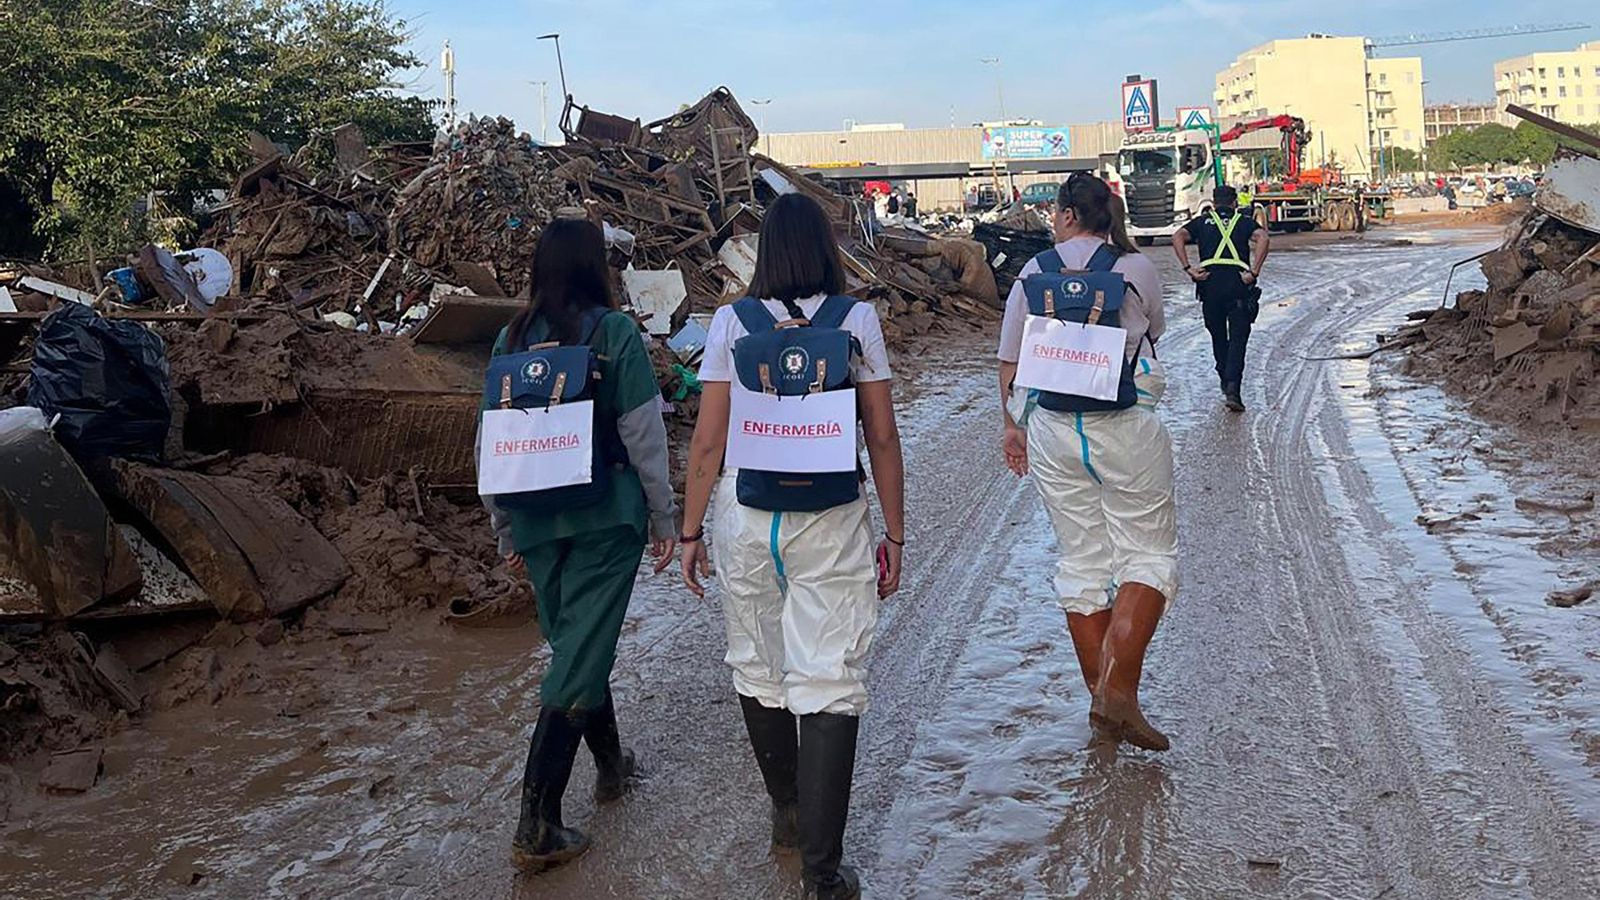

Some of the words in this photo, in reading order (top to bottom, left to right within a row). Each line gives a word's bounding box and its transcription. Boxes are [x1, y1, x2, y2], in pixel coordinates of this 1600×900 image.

[1033, 343, 1110, 365] ENFERMERÍA
[743, 419, 842, 436] ENFERMERÍA
[494, 433, 580, 454] ENFERMERÍA
